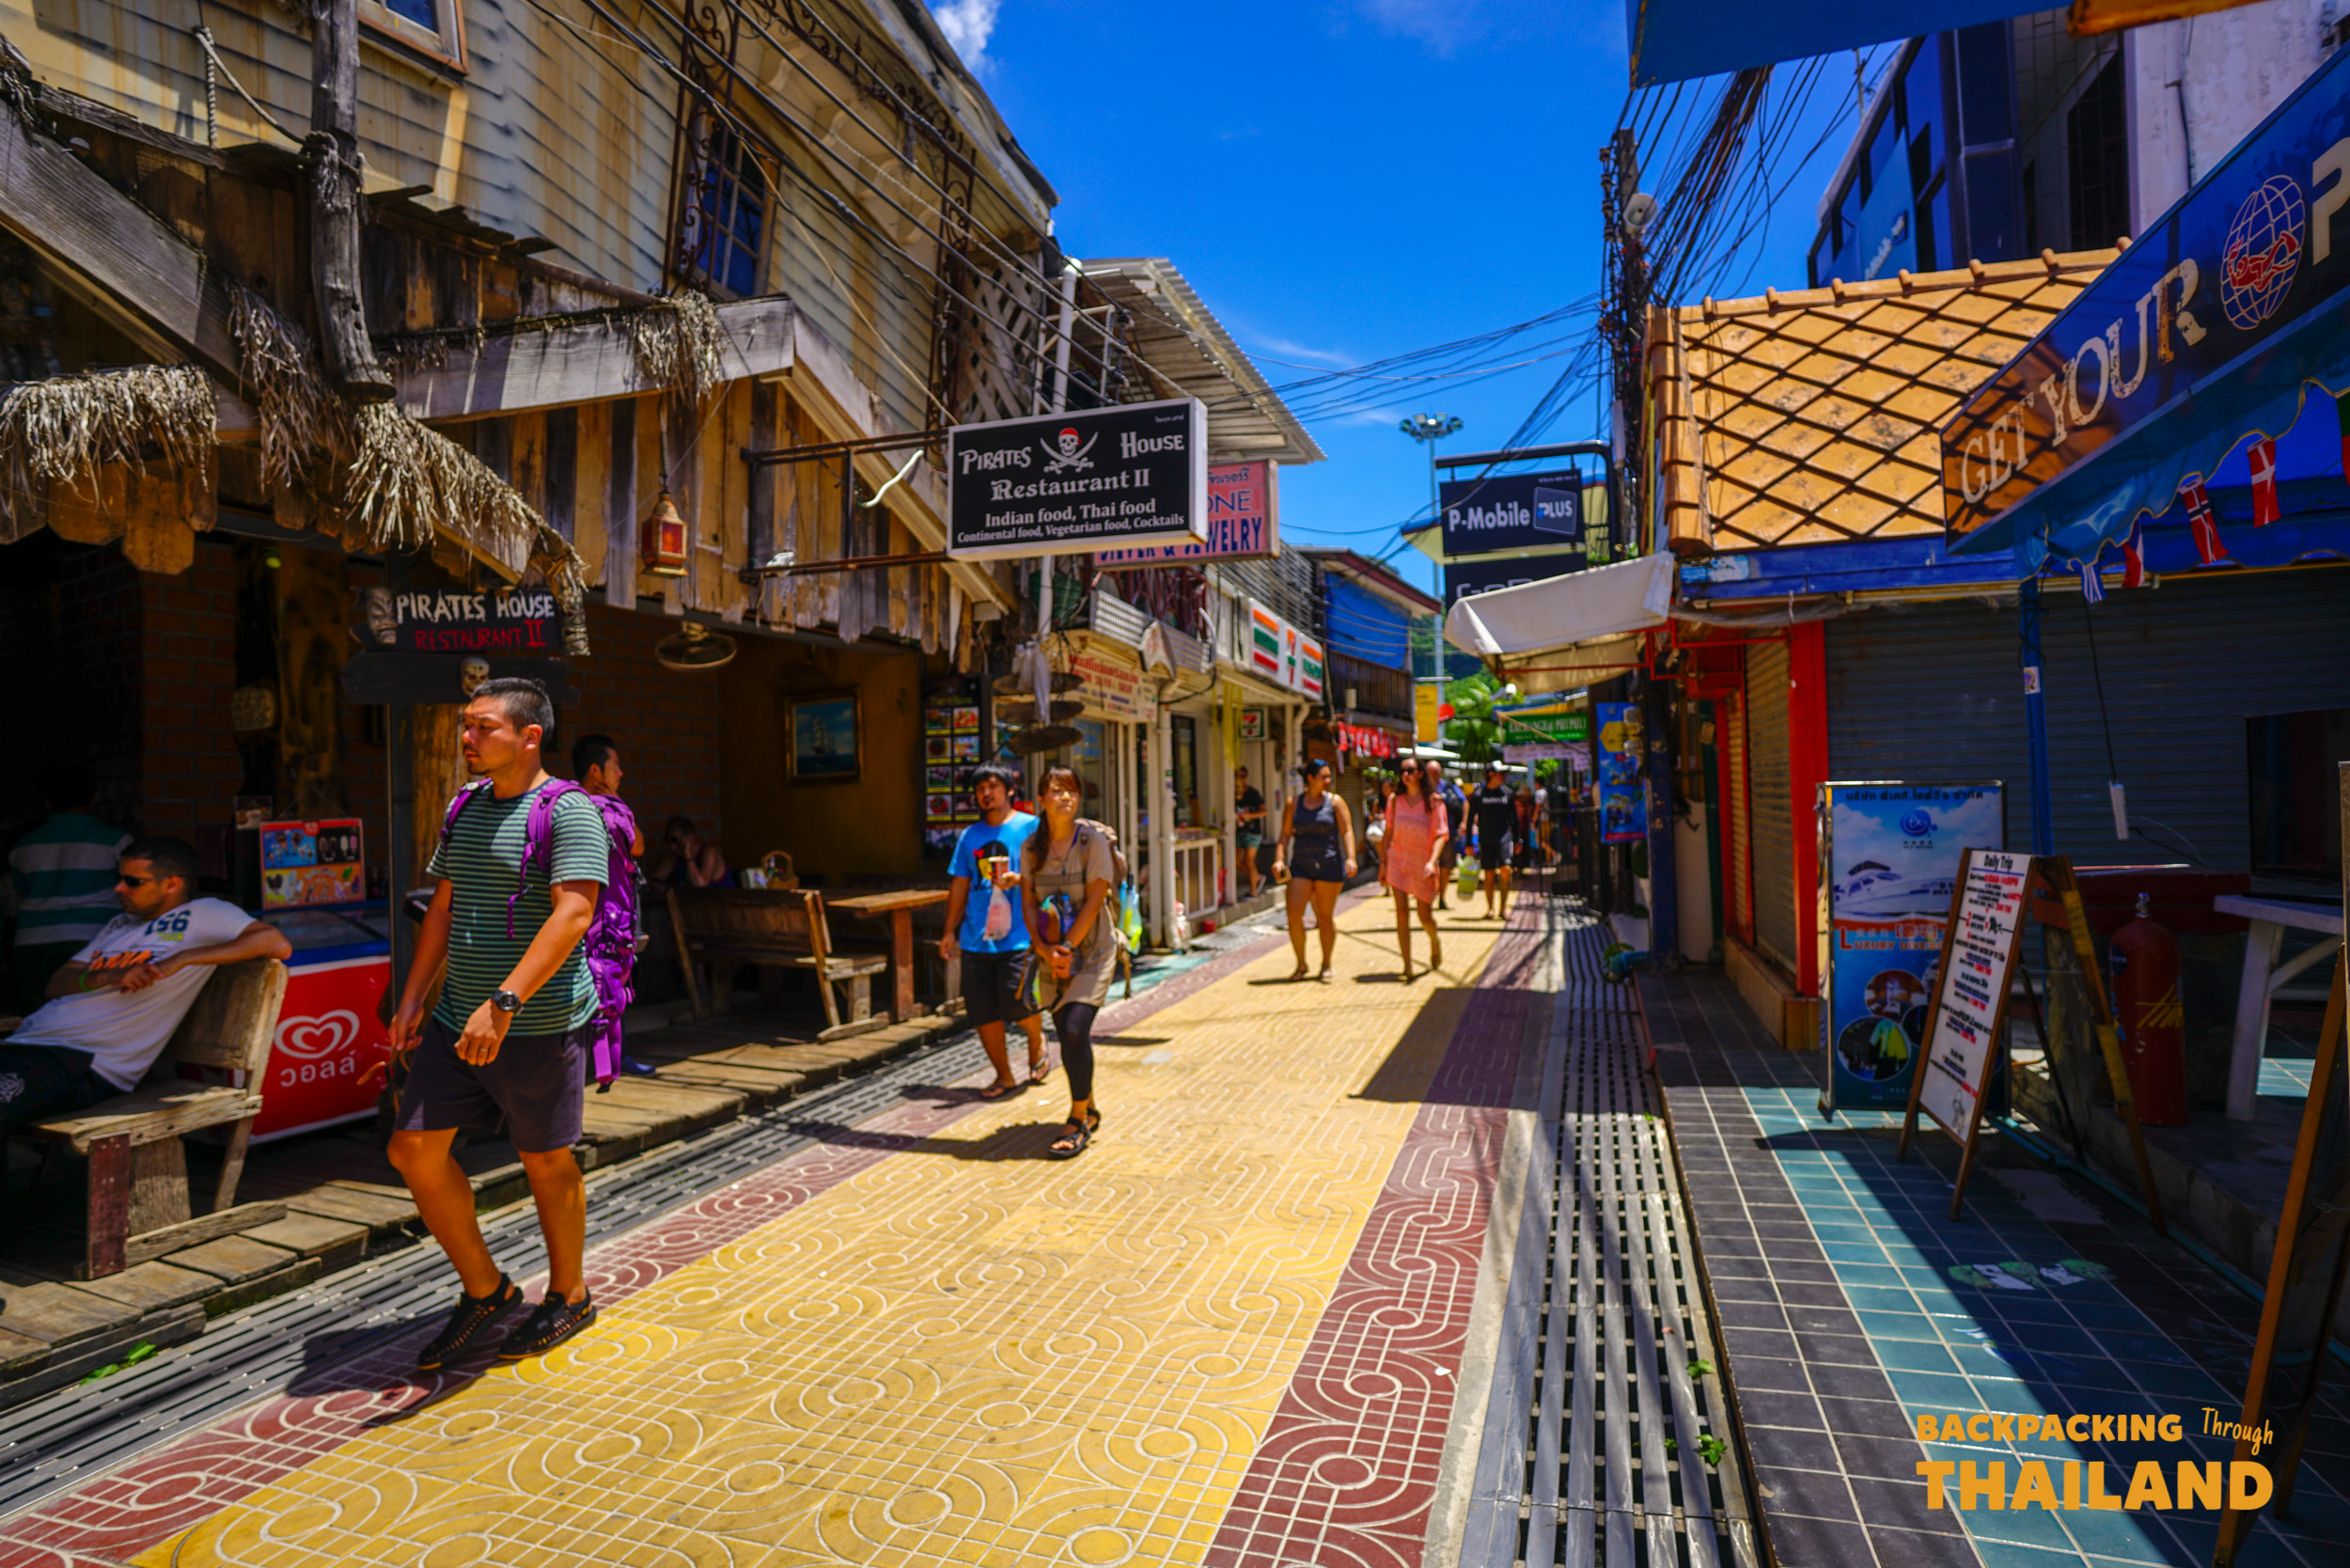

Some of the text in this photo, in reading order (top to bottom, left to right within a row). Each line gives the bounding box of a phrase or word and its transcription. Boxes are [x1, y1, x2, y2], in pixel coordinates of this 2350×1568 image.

[1961, 257, 2208, 504] GET YOUR
[958, 431, 1185, 475] PIRATES HOUSE
[991, 468, 1152, 502] Restaurant II
[957, 512, 1185, 543] Continental food, Vegetarian food, Cocktails
[985, 497, 1157, 527] Indian food, Thai food
[1448, 500, 1531, 533] P-Mobile
[396, 588, 556, 624] PIRATES HOUSE
[415, 619, 548, 651] RESTAURANT II
[1983, 854, 2013, 873] Daily Trip
[1840, 926, 1896, 951] LUXURY
[1899, 940, 1928, 951] DIVE
[280, 1049, 357, 1088] วอลล์
